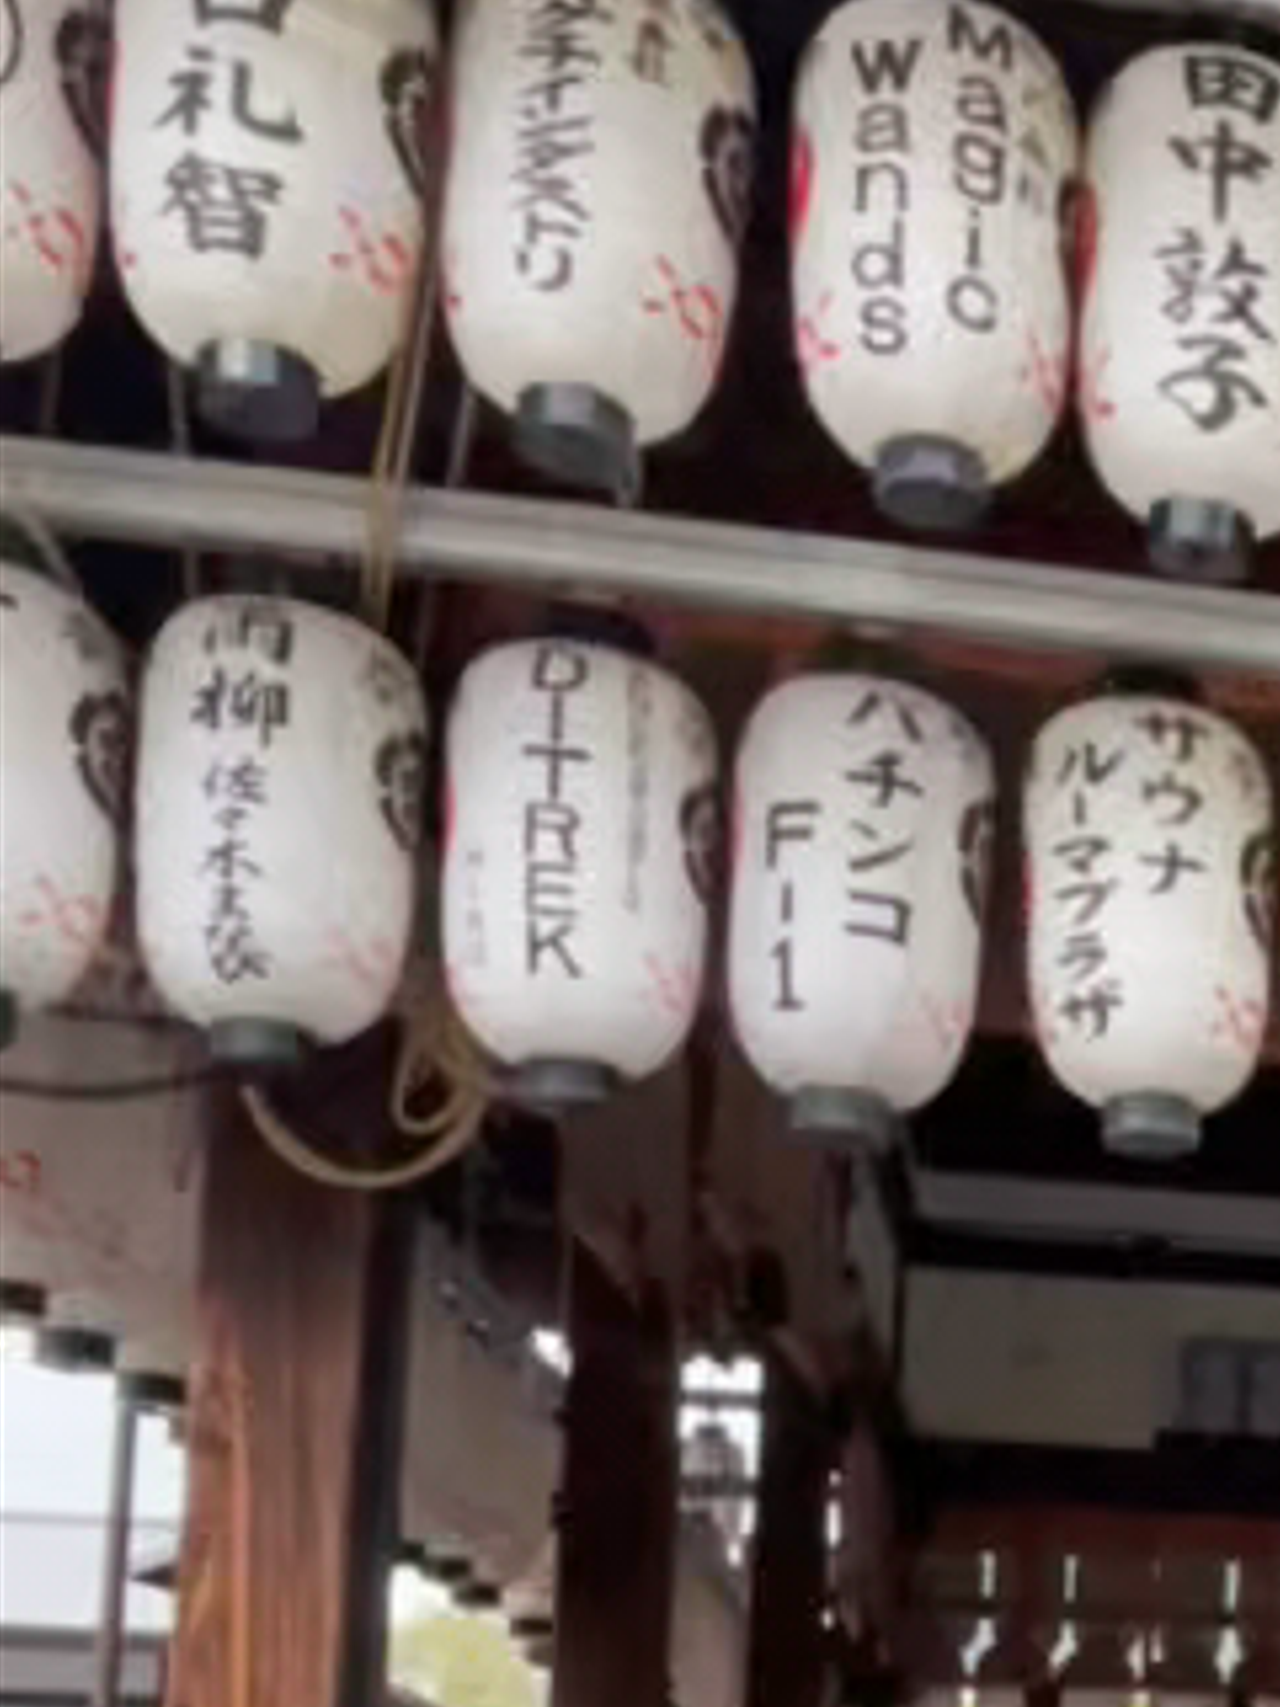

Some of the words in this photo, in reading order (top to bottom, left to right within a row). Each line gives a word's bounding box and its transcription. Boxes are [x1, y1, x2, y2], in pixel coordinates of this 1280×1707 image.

[849, 37, 922, 357] Wands
[945, 3, 1016, 335] Magic
[1136, 711, 1206, 895] サウナ
